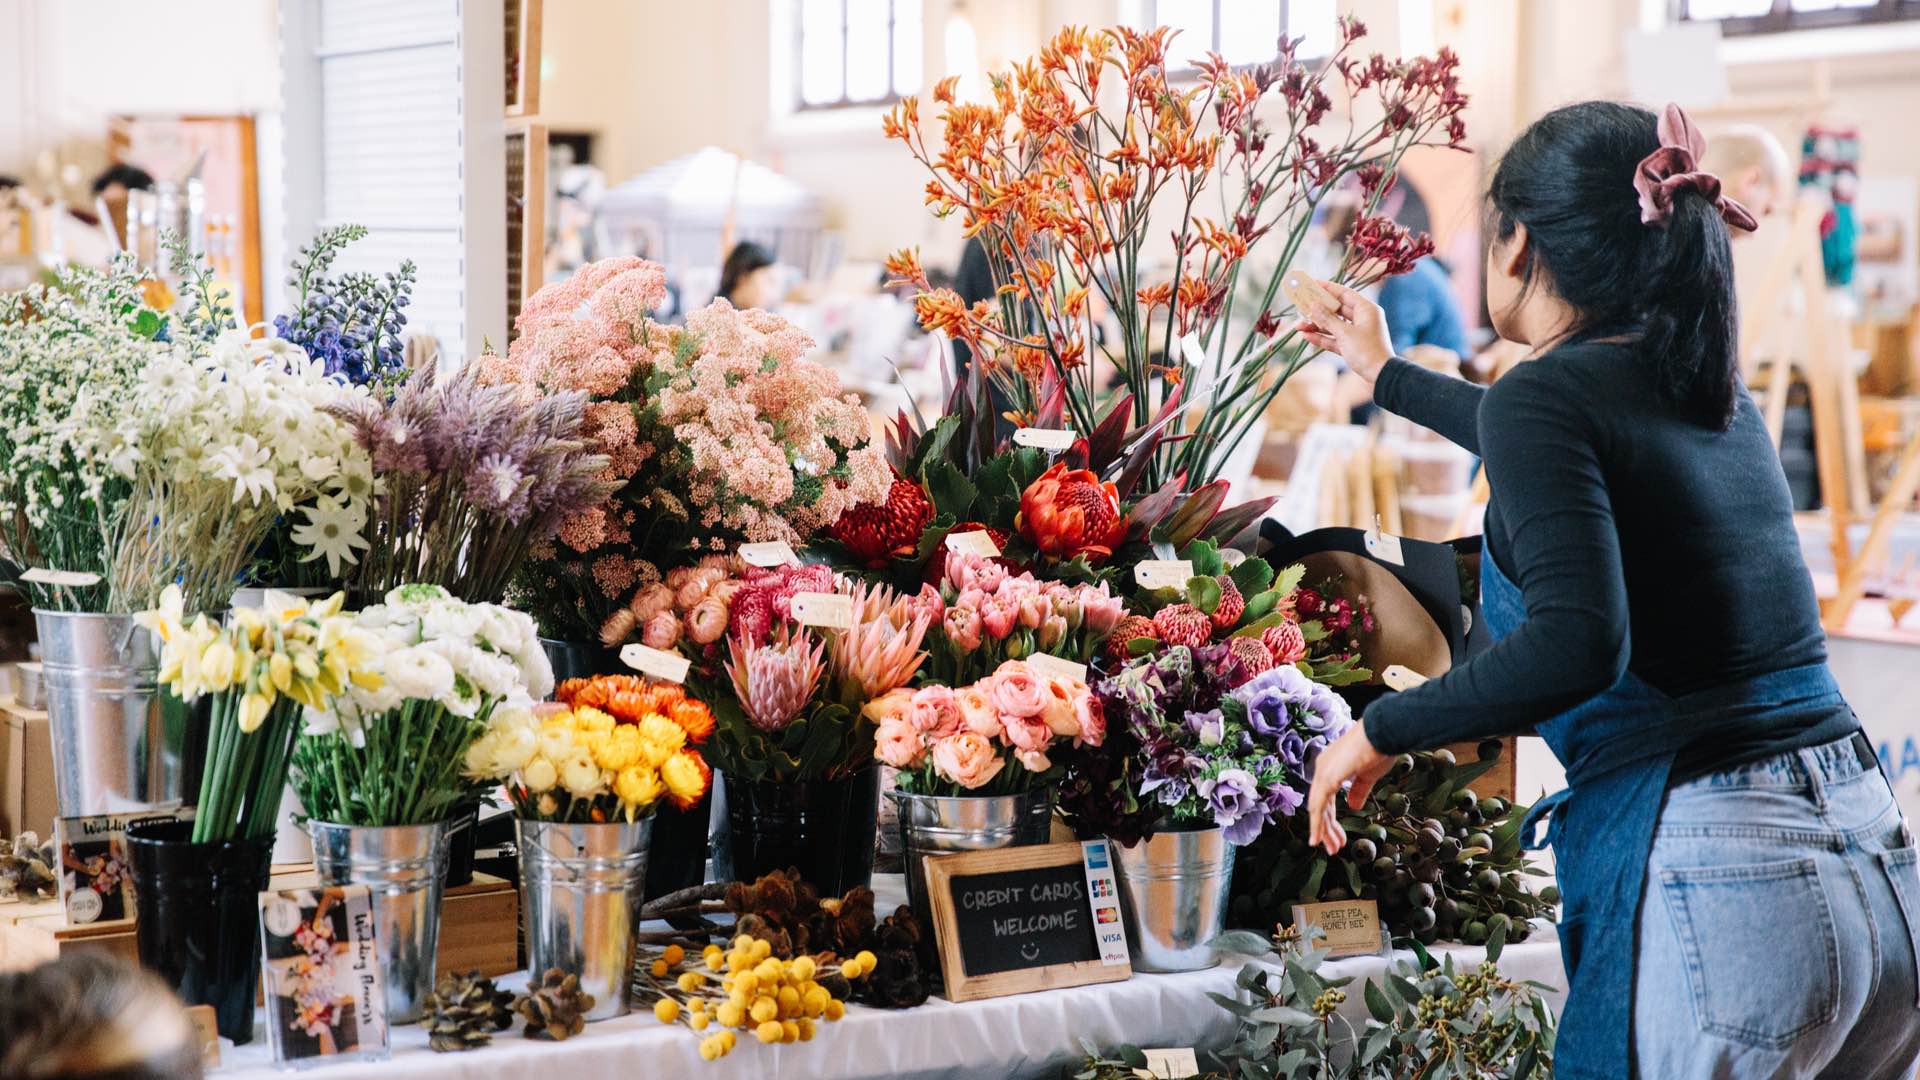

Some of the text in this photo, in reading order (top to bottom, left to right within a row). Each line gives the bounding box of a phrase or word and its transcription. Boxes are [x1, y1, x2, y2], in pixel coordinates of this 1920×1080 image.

[963, 881, 1082, 909] CREDIT CARDS
[1321, 910, 1345, 920] SWEET
[1347, 908, 1362, 918] PEA
[993, 909, 1078, 936] WELCOME
[1349, 919, 1365, 928] BEE
[1102, 933, 1122, 943] VISA
